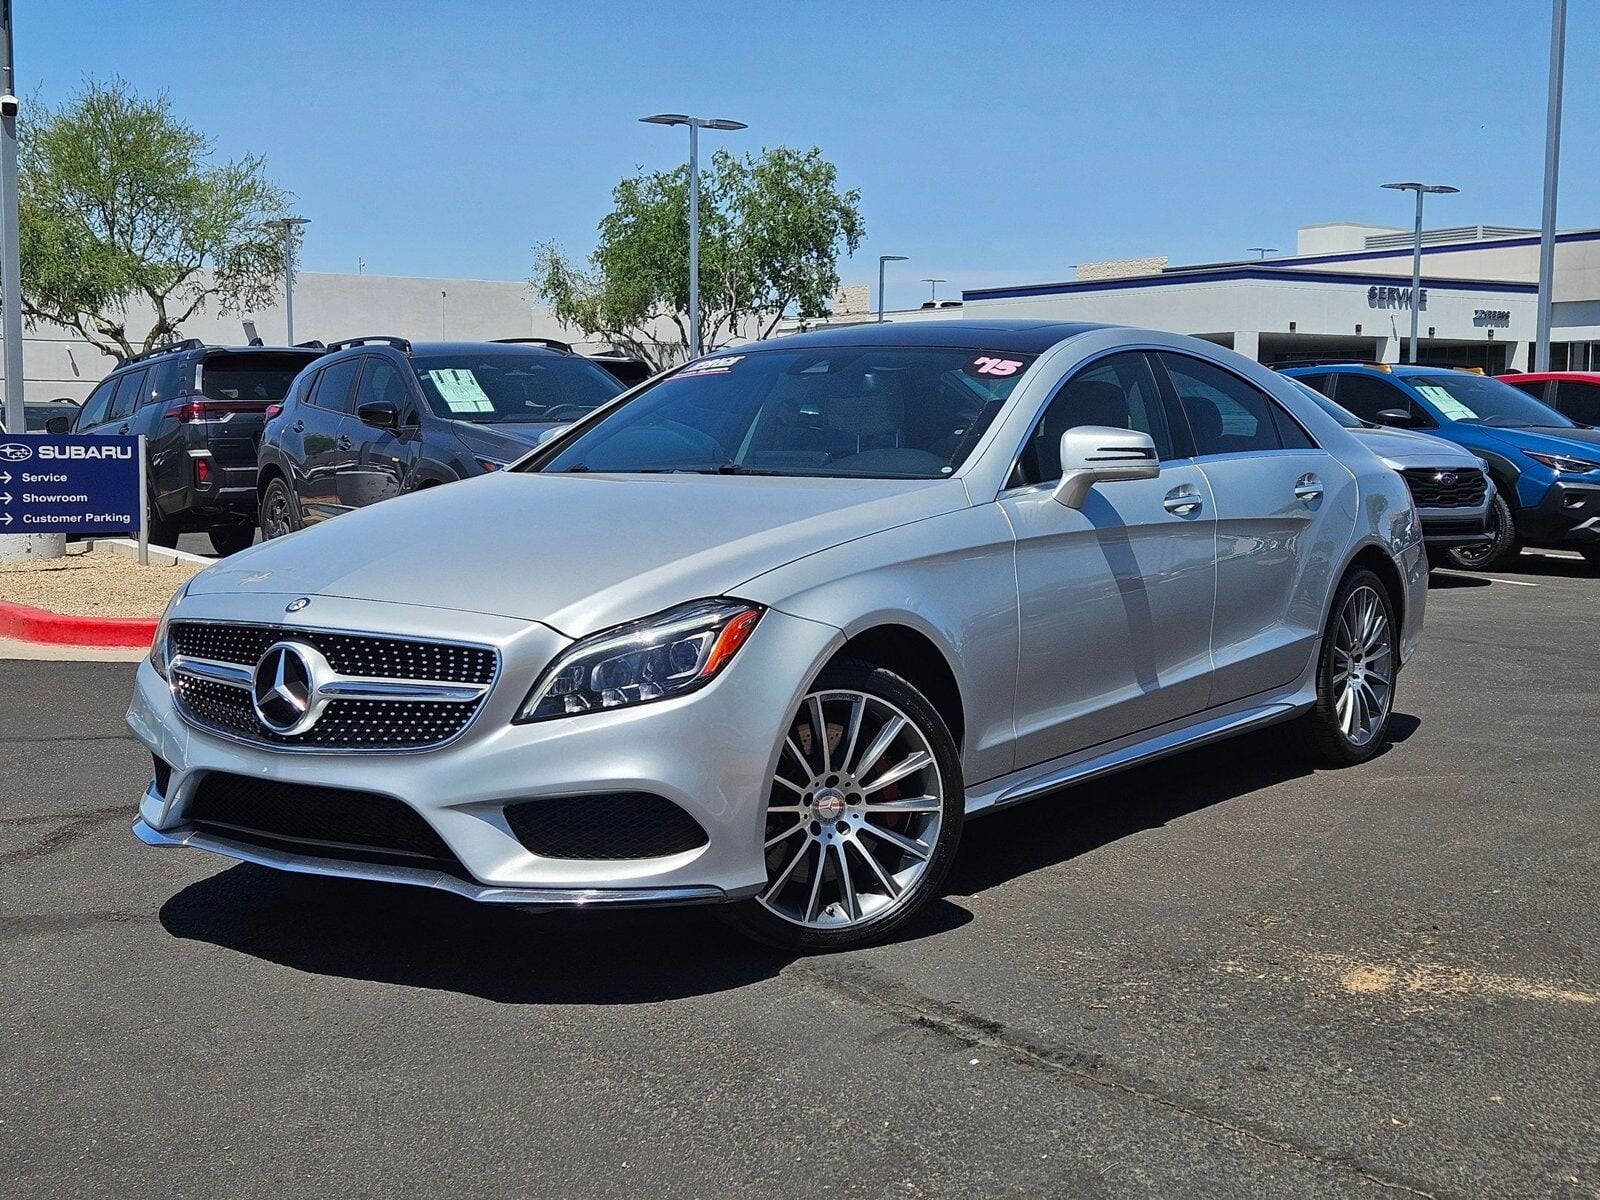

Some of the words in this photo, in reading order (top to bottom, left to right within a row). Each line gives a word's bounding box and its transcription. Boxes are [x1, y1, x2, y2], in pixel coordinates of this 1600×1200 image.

[38, 445, 132, 460] SUBARU
[22, 472, 68, 483] Service
[22, 493, 88, 503] Showroom
[23, 514, 82, 524] Customer
[85, 512, 131, 524] Parking
